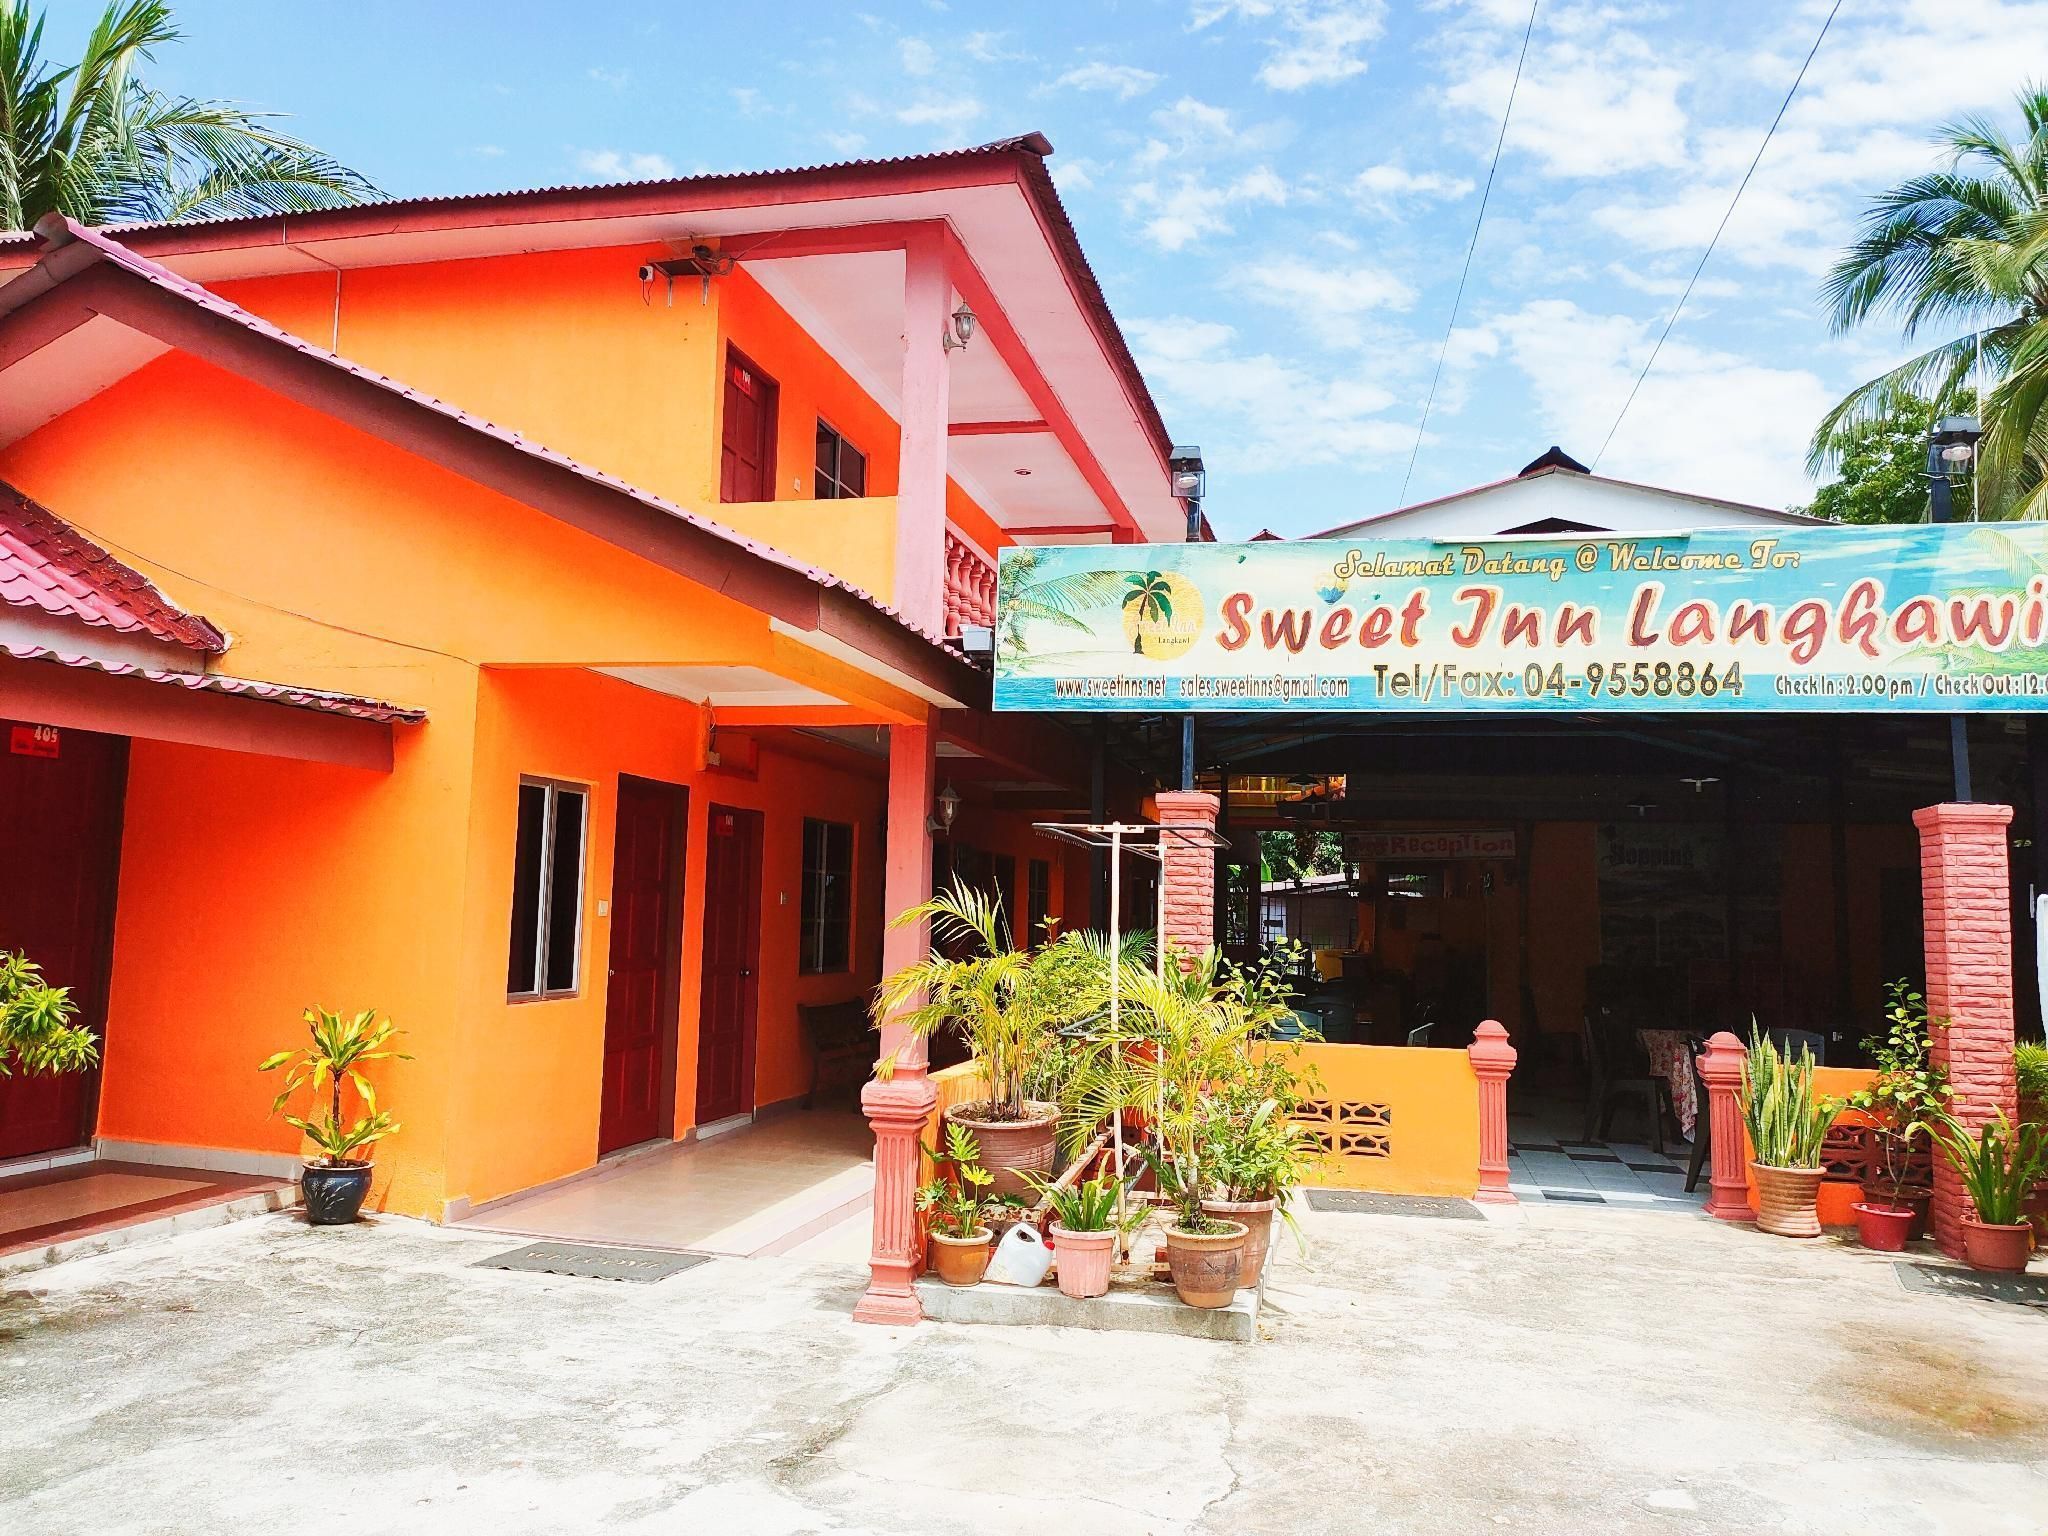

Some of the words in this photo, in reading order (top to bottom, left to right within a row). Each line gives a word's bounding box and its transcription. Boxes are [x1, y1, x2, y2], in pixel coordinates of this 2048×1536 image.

[1334, 549, 1456, 578] Selamat
[1461, 547, 1567, 582] Datang
[1575, 543, 1599, 572] @
[1607, 543, 1744, 572] Welcome
[1749, 539, 1801, 569] To:
[1216, 590, 1428, 654] Sweet
[1451, 587, 1598, 648] Inn
[1625, 579, 2045, 667] Langkawi
[1056, 675, 1166, 697] www.sweetinns.net
[1180, 674, 1349, 702] sales.sweetinns@gmail.com
[1373, 663, 1516, 701] Tel/Fax:
[1523, 662, 1744, 698] 04-9558864
[34, 725, 59, 743] 405
